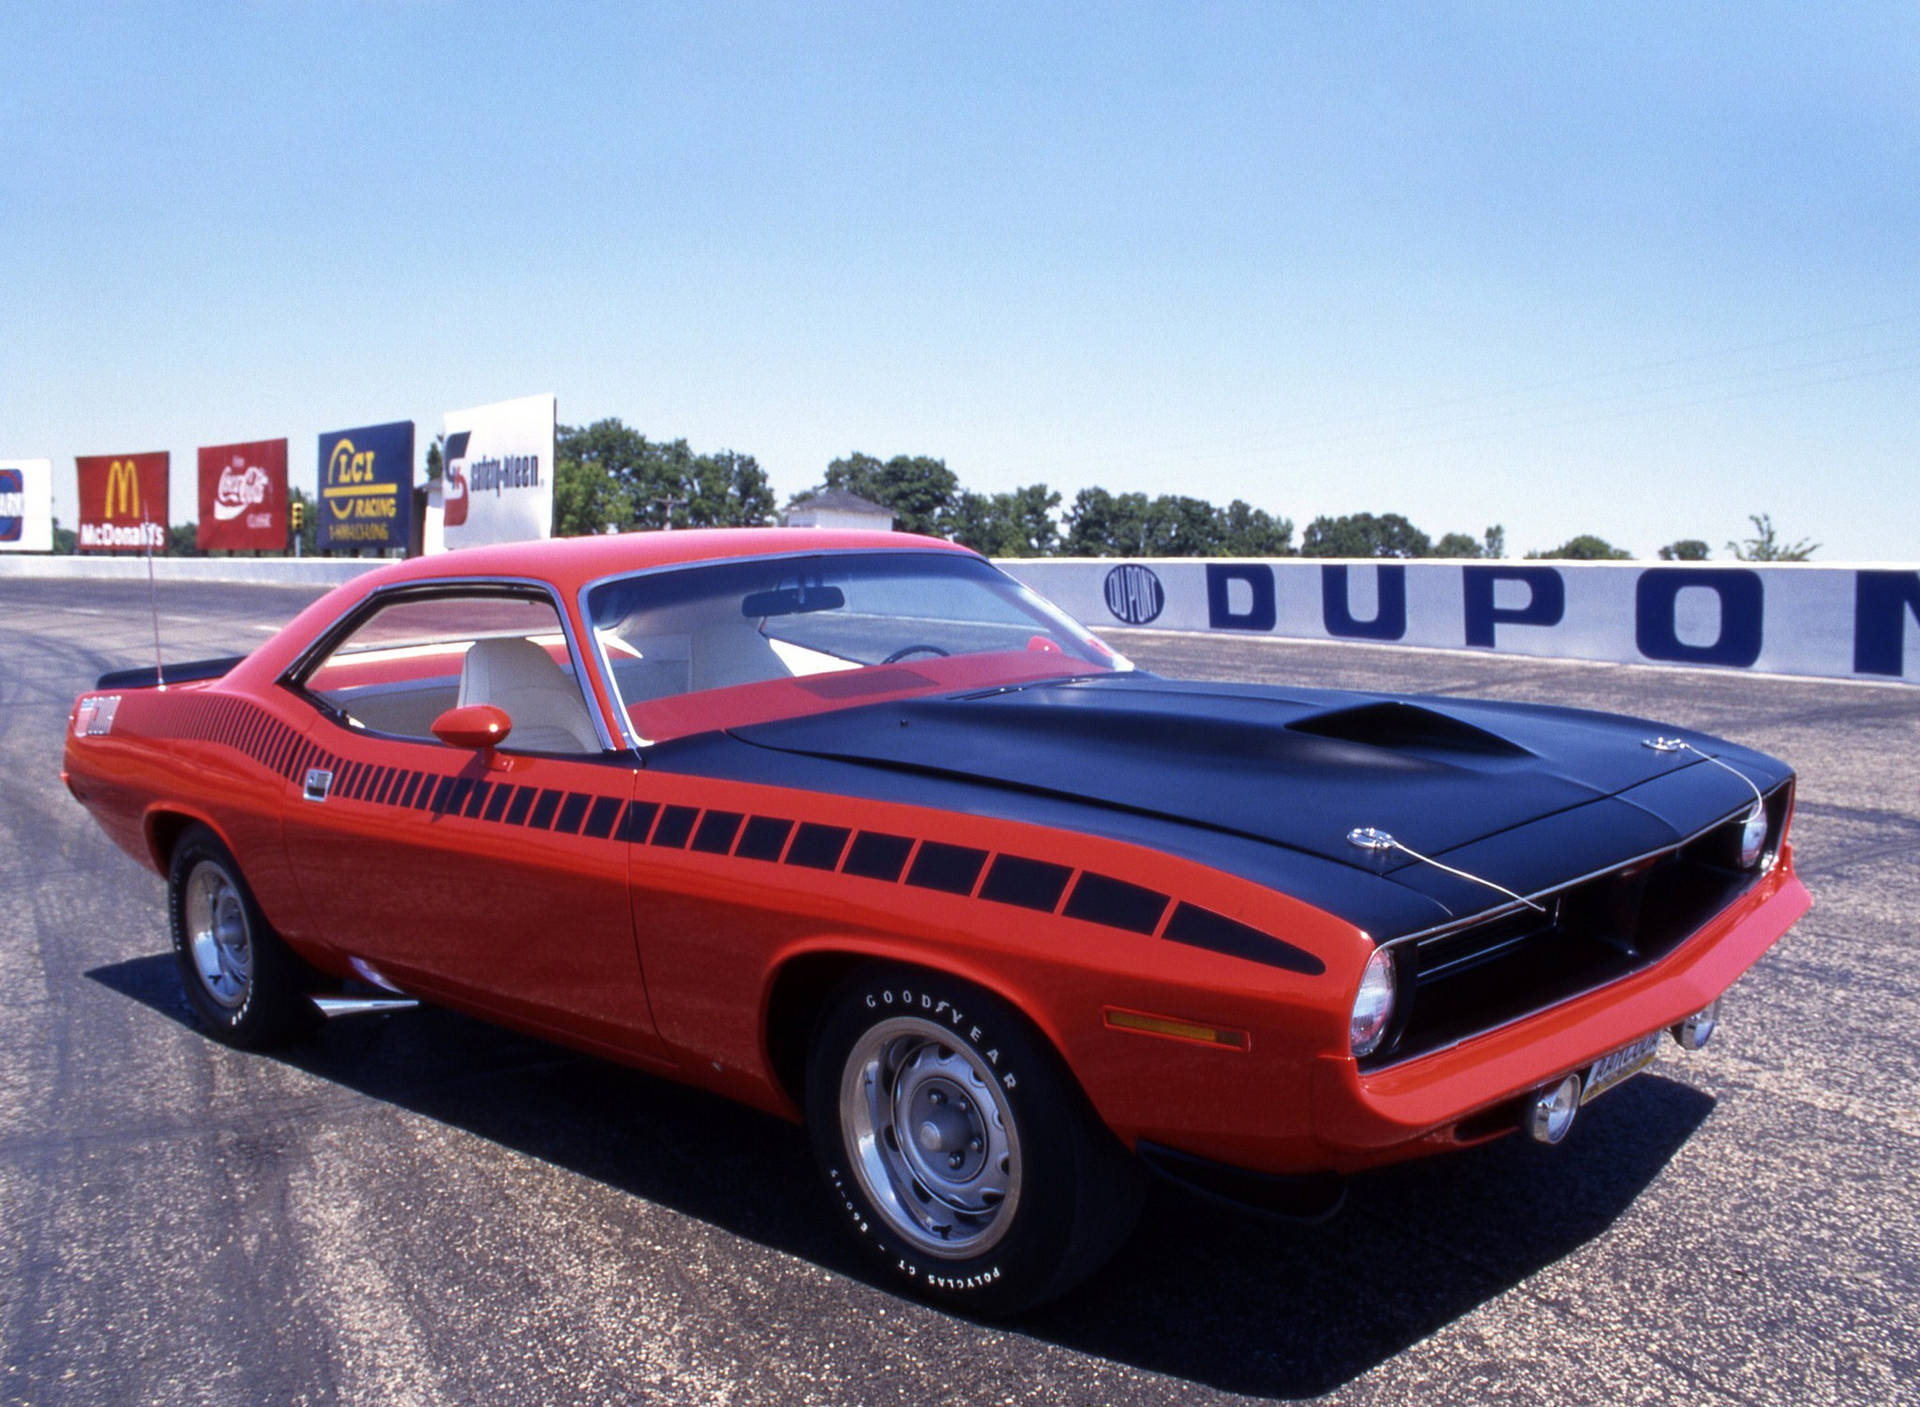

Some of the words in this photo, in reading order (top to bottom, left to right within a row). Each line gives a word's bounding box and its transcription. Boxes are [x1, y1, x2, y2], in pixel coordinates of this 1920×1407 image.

[339, 451, 375, 483] LCI
[355, 498, 396, 517] RACING
[80, 522, 165, 546] McDonald's
[866, 990, 1017, 1089] GOODYEAR
